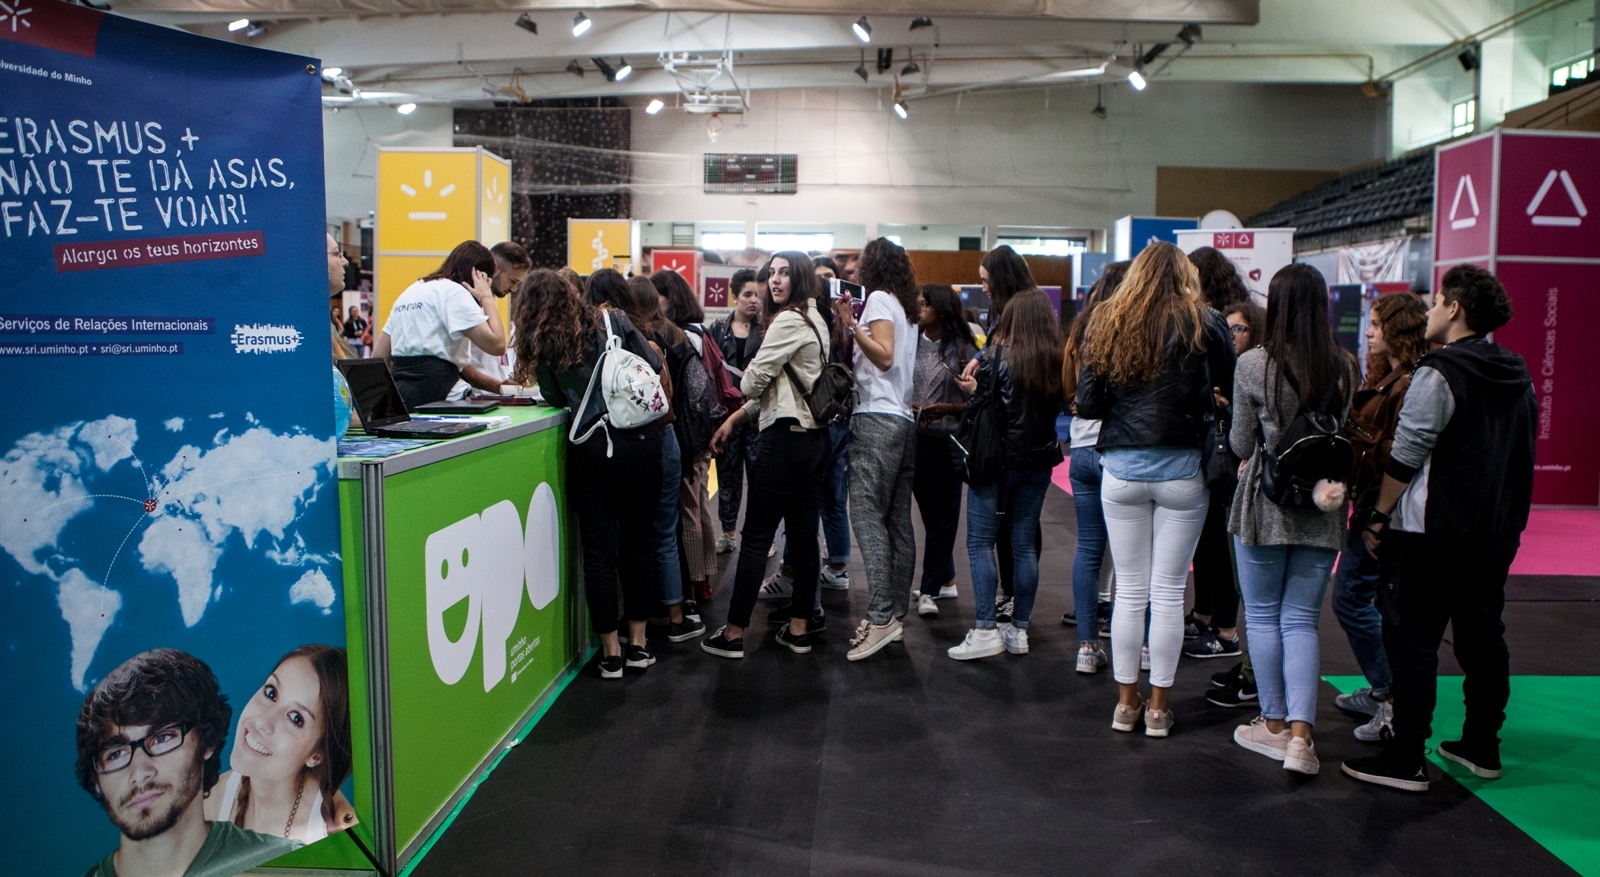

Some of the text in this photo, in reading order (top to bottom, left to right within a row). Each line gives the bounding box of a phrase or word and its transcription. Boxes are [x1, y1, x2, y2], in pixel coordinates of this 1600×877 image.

[0, 60, 92, 86] iversidade do Minho
[0, 117, 167, 155] ERASMUS
[0, 149, 295, 195] NÃO TE DÁ ASAS,
[1, 193, 248, 238] FAZ-TE VOAR!
[62, 237, 259, 265] Alarga os teus horizontes
[0, 317, 209, 334] Serviços de Relações Internacionais
[237, 333, 299, 345] Erasmus+
[0, 344, 178, 355] www.sri.uminho.pt sri@sri.uminho.pt
[1538, 287, 1559, 440] Instituto de Ciências Sociais
